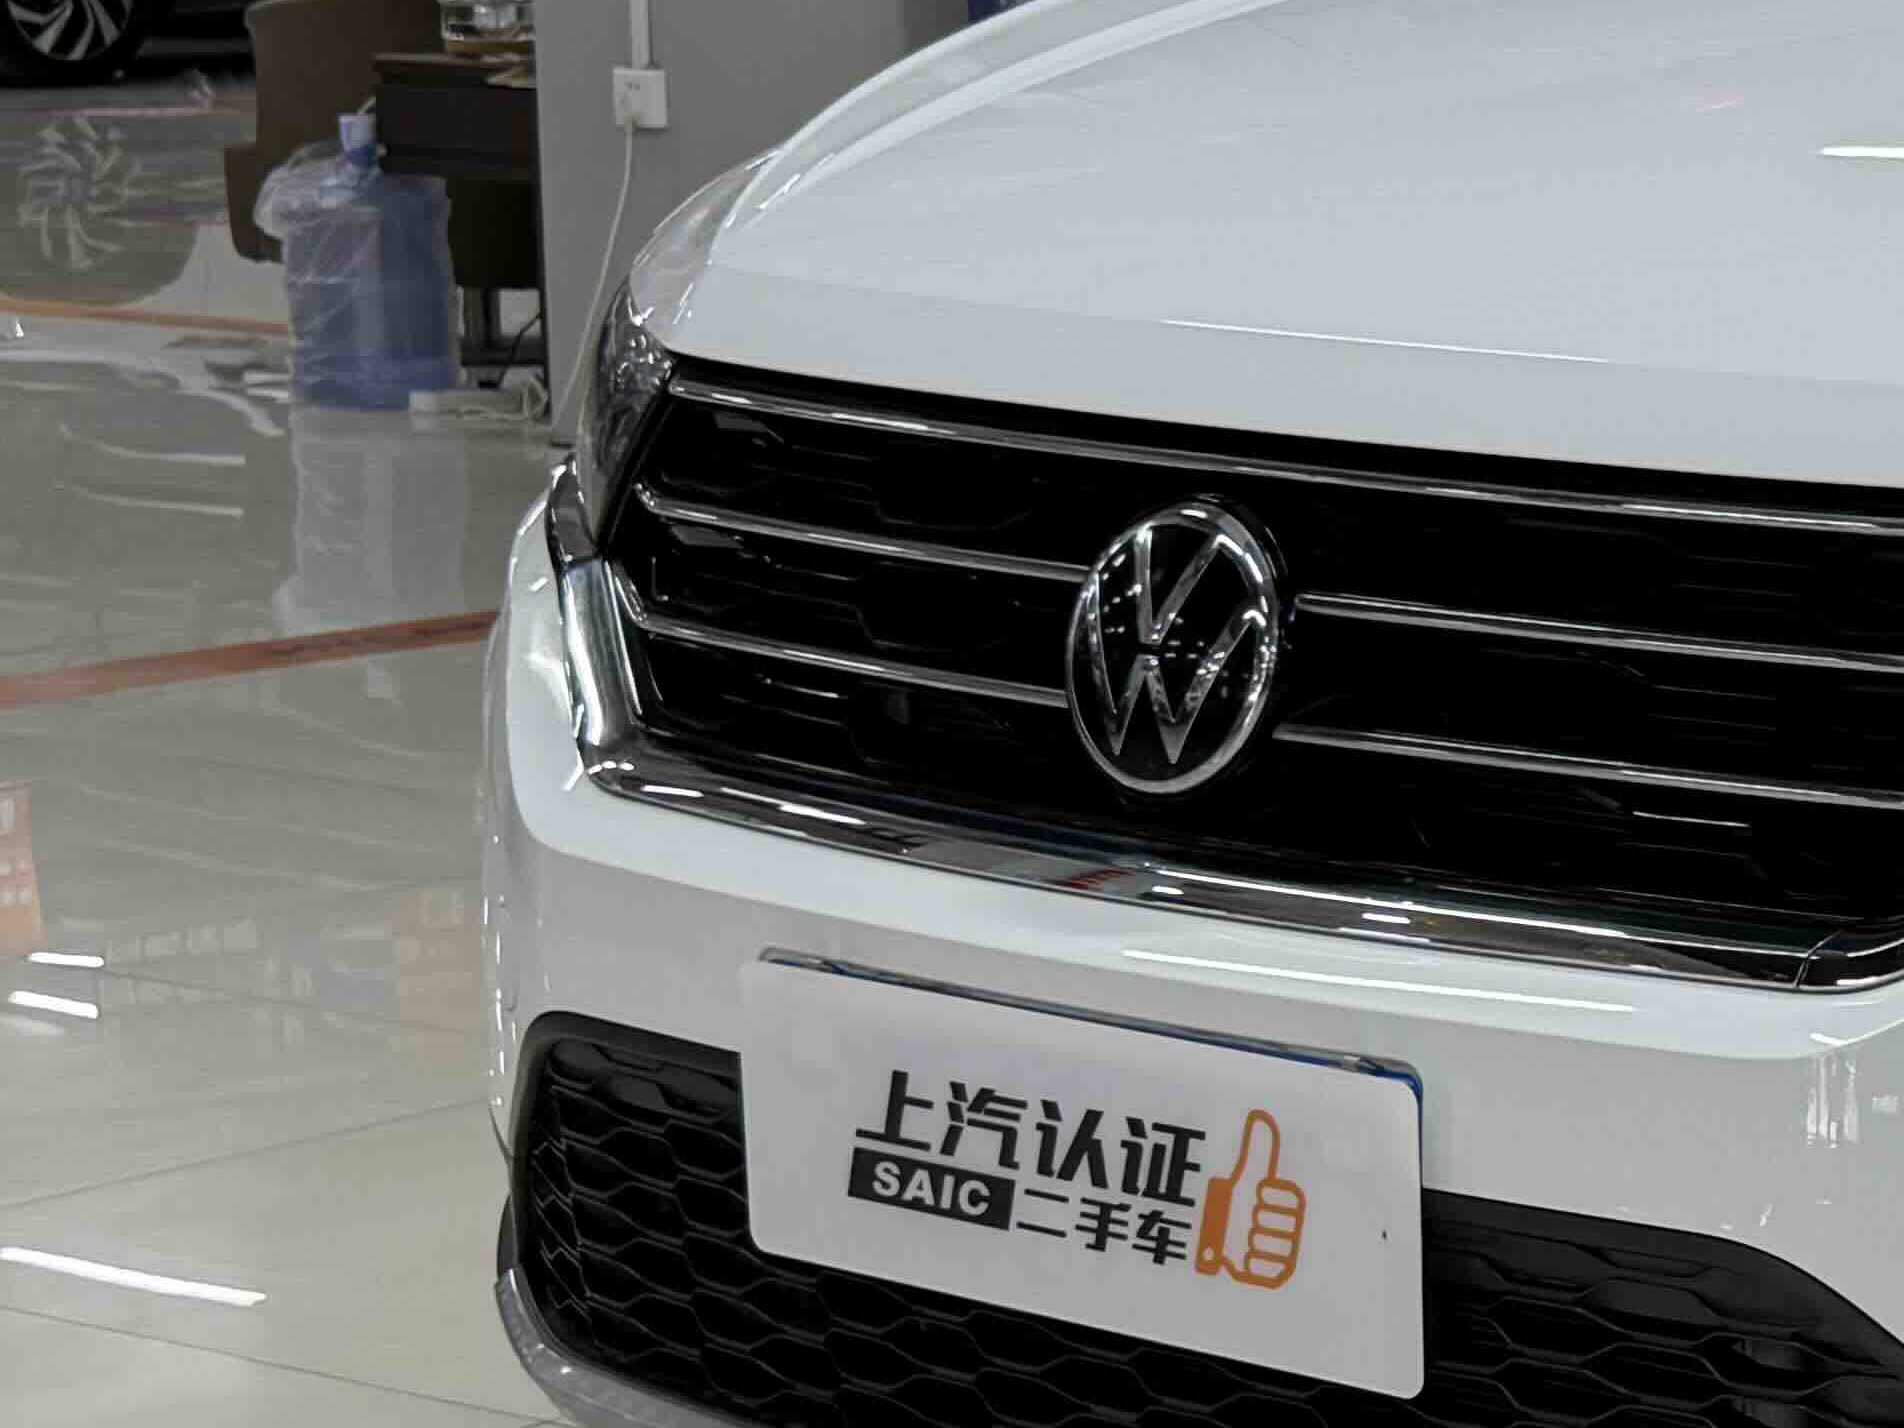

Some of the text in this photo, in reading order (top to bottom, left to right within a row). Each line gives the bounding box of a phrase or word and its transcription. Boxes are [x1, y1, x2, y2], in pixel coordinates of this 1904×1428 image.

[855, 1069, 1206, 1206] 上汽认证
[872, 1162, 1192, 1265] SAIC 二手车
